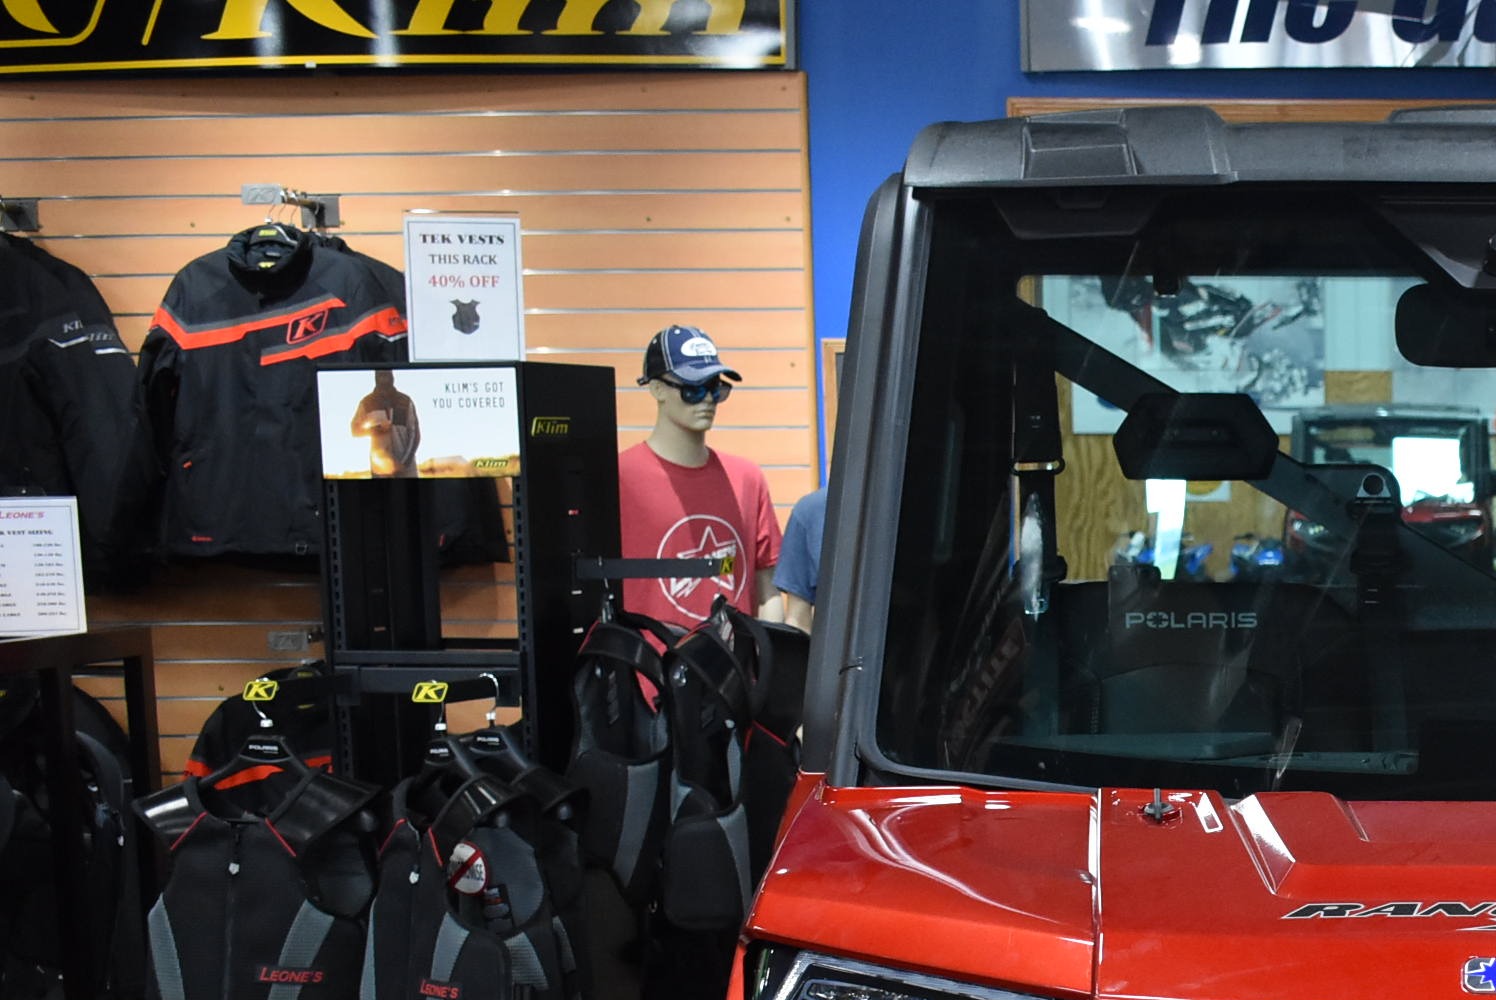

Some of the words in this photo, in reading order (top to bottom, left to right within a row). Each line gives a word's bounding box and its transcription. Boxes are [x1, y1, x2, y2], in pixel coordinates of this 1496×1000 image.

[420, 233, 452, 244] TEK
[457, 234, 505, 245] VESTS
[429, 254, 460, 265] THIS
[463, 254, 498, 265] RACK
[428, 275, 465, 288] 40%
[470, 275, 500, 288] OFF
[445, 382, 479, 393] KLIM'S
[485, 382, 504, 393] GOT
[432, 397, 452, 409] YOU
[458, 397, 505, 409] COVERED
[1125, 612, 1258, 629] POLARIS
[260, 967, 324, 983] LEONE'S
[420, 979, 460, 999] LEONE'S
